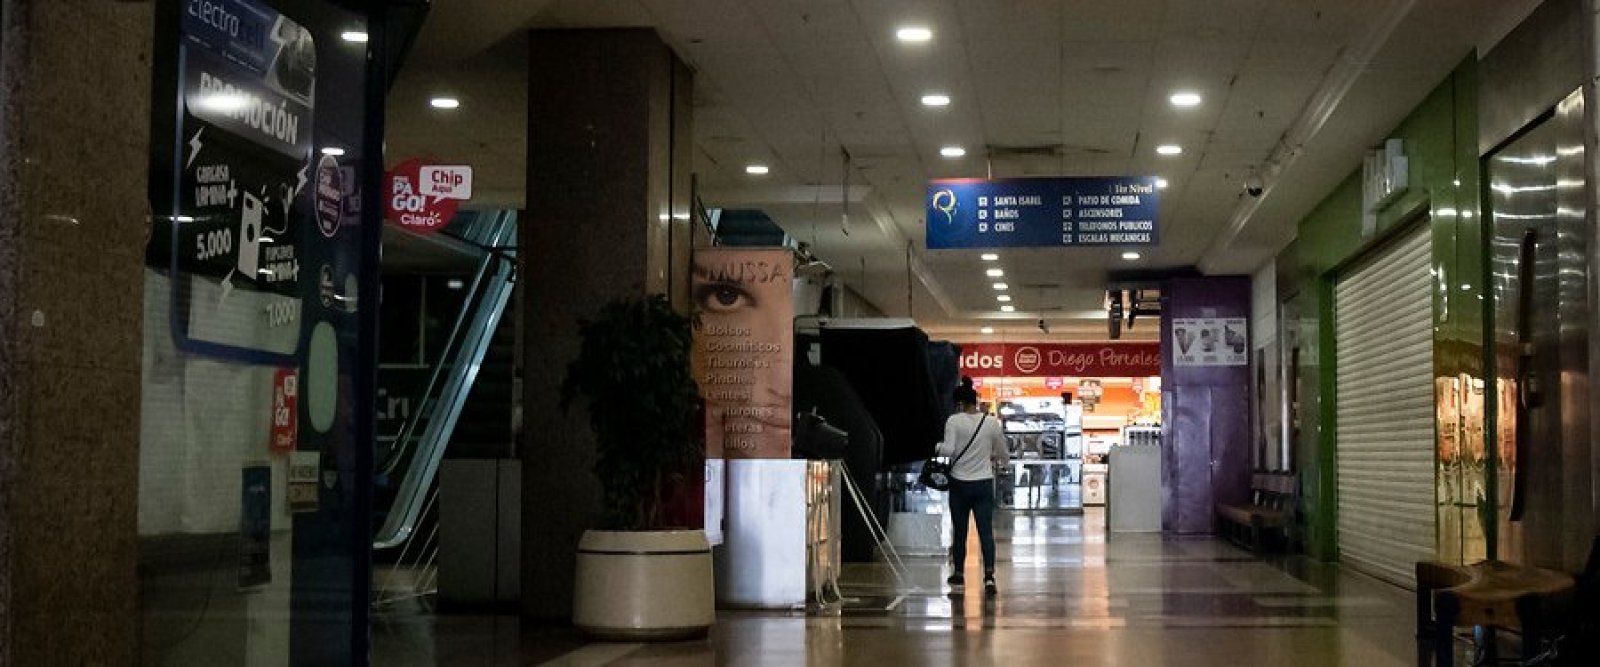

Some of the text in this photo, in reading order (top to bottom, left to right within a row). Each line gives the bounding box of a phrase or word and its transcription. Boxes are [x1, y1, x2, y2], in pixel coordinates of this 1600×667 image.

[432, 169, 462, 187] Chip
[1129, 184, 1153, 193] Nivel
[392, 195, 426, 212] GO!
[994, 195, 1042, 206] SANTA ISABEL
[1079, 195, 1140, 206] PATIO DE COMIDA
[994, 207, 1020, 219] BAÑOS
[1079, 208, 1122, 218] ASCENSORES
[401, 212, 435, 226] Claro
[994, 222, 1015, 232] CINES
[1079, 233, 1108, 243] ESCALAS
[705, 324, 752, 338] Bolsos
[1049, 350, 1094, 372] Diego
[1099, 348, 1161, 369] Portales
